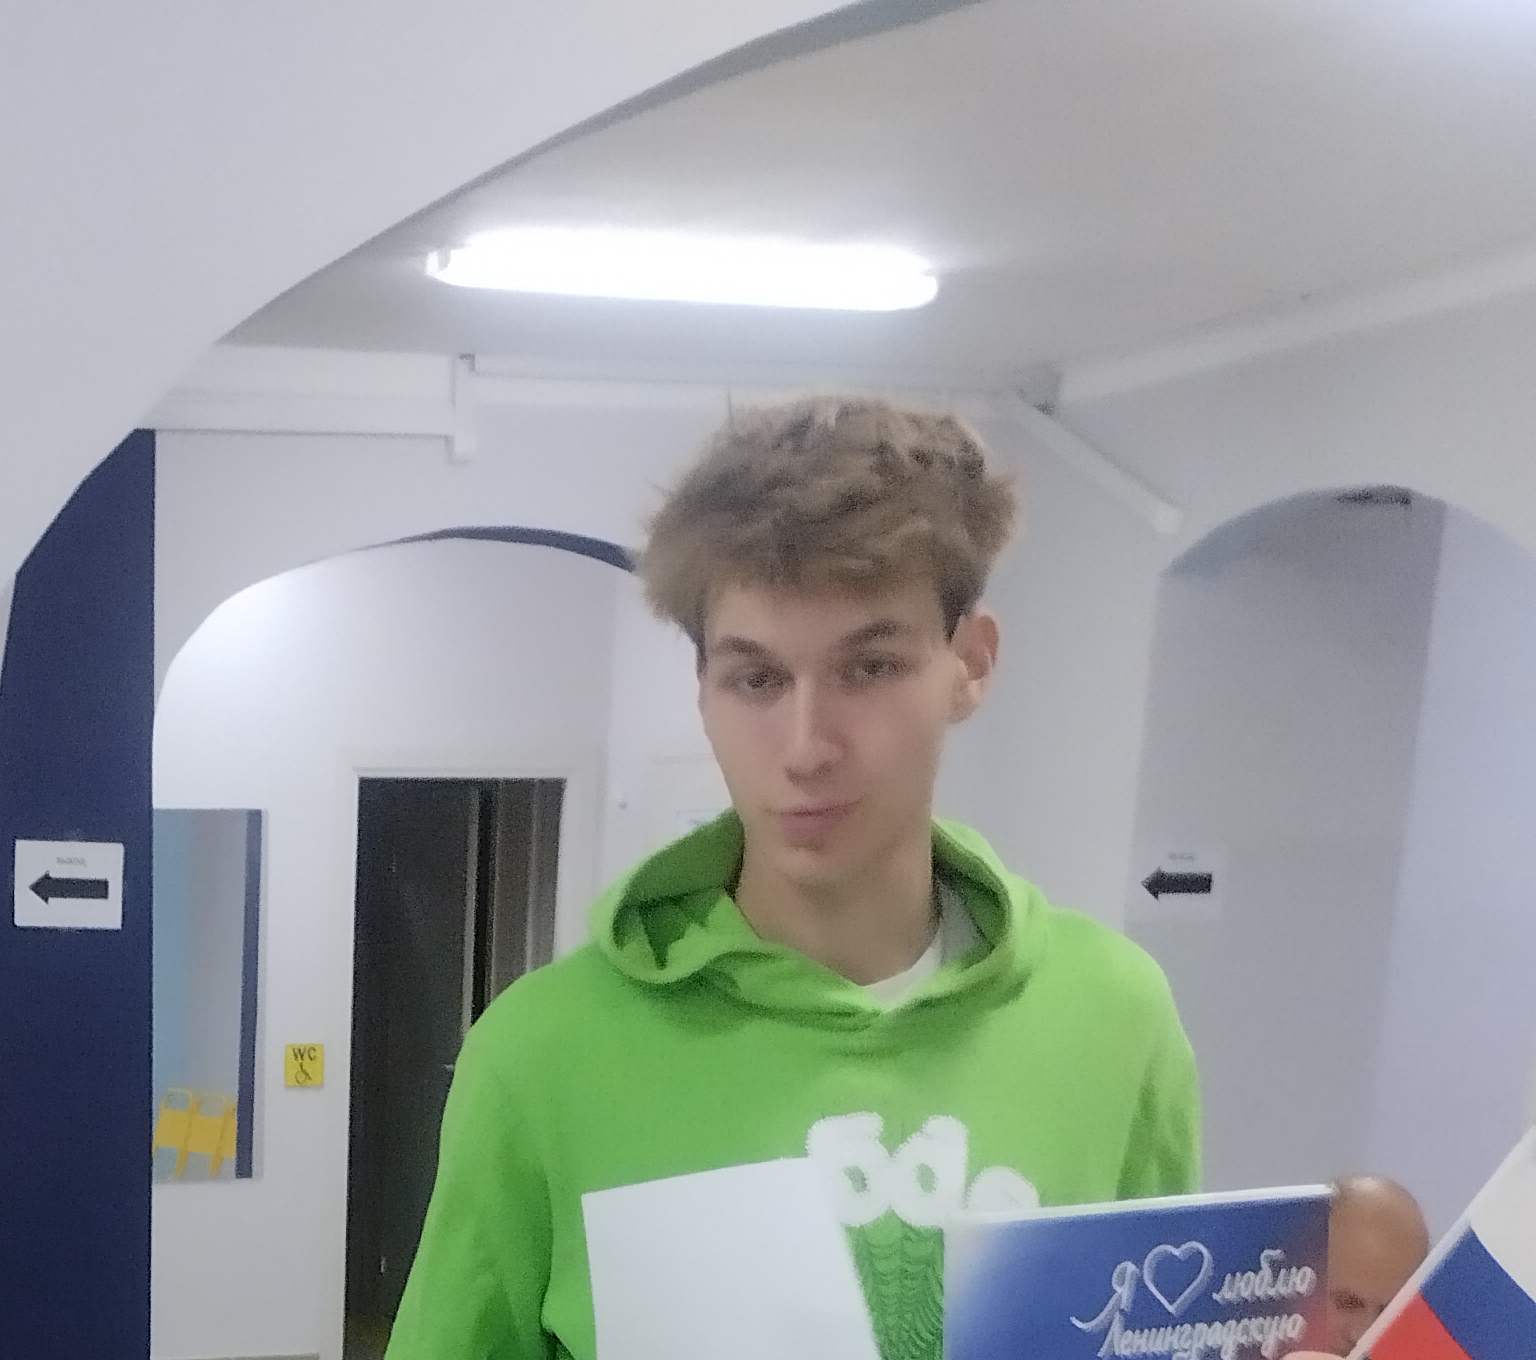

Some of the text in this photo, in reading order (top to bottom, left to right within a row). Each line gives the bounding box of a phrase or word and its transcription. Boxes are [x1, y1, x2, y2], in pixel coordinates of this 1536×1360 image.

[292, 1047, 317, 1061] WC
[1070, 1250, 1315, 1331] Я люблю
